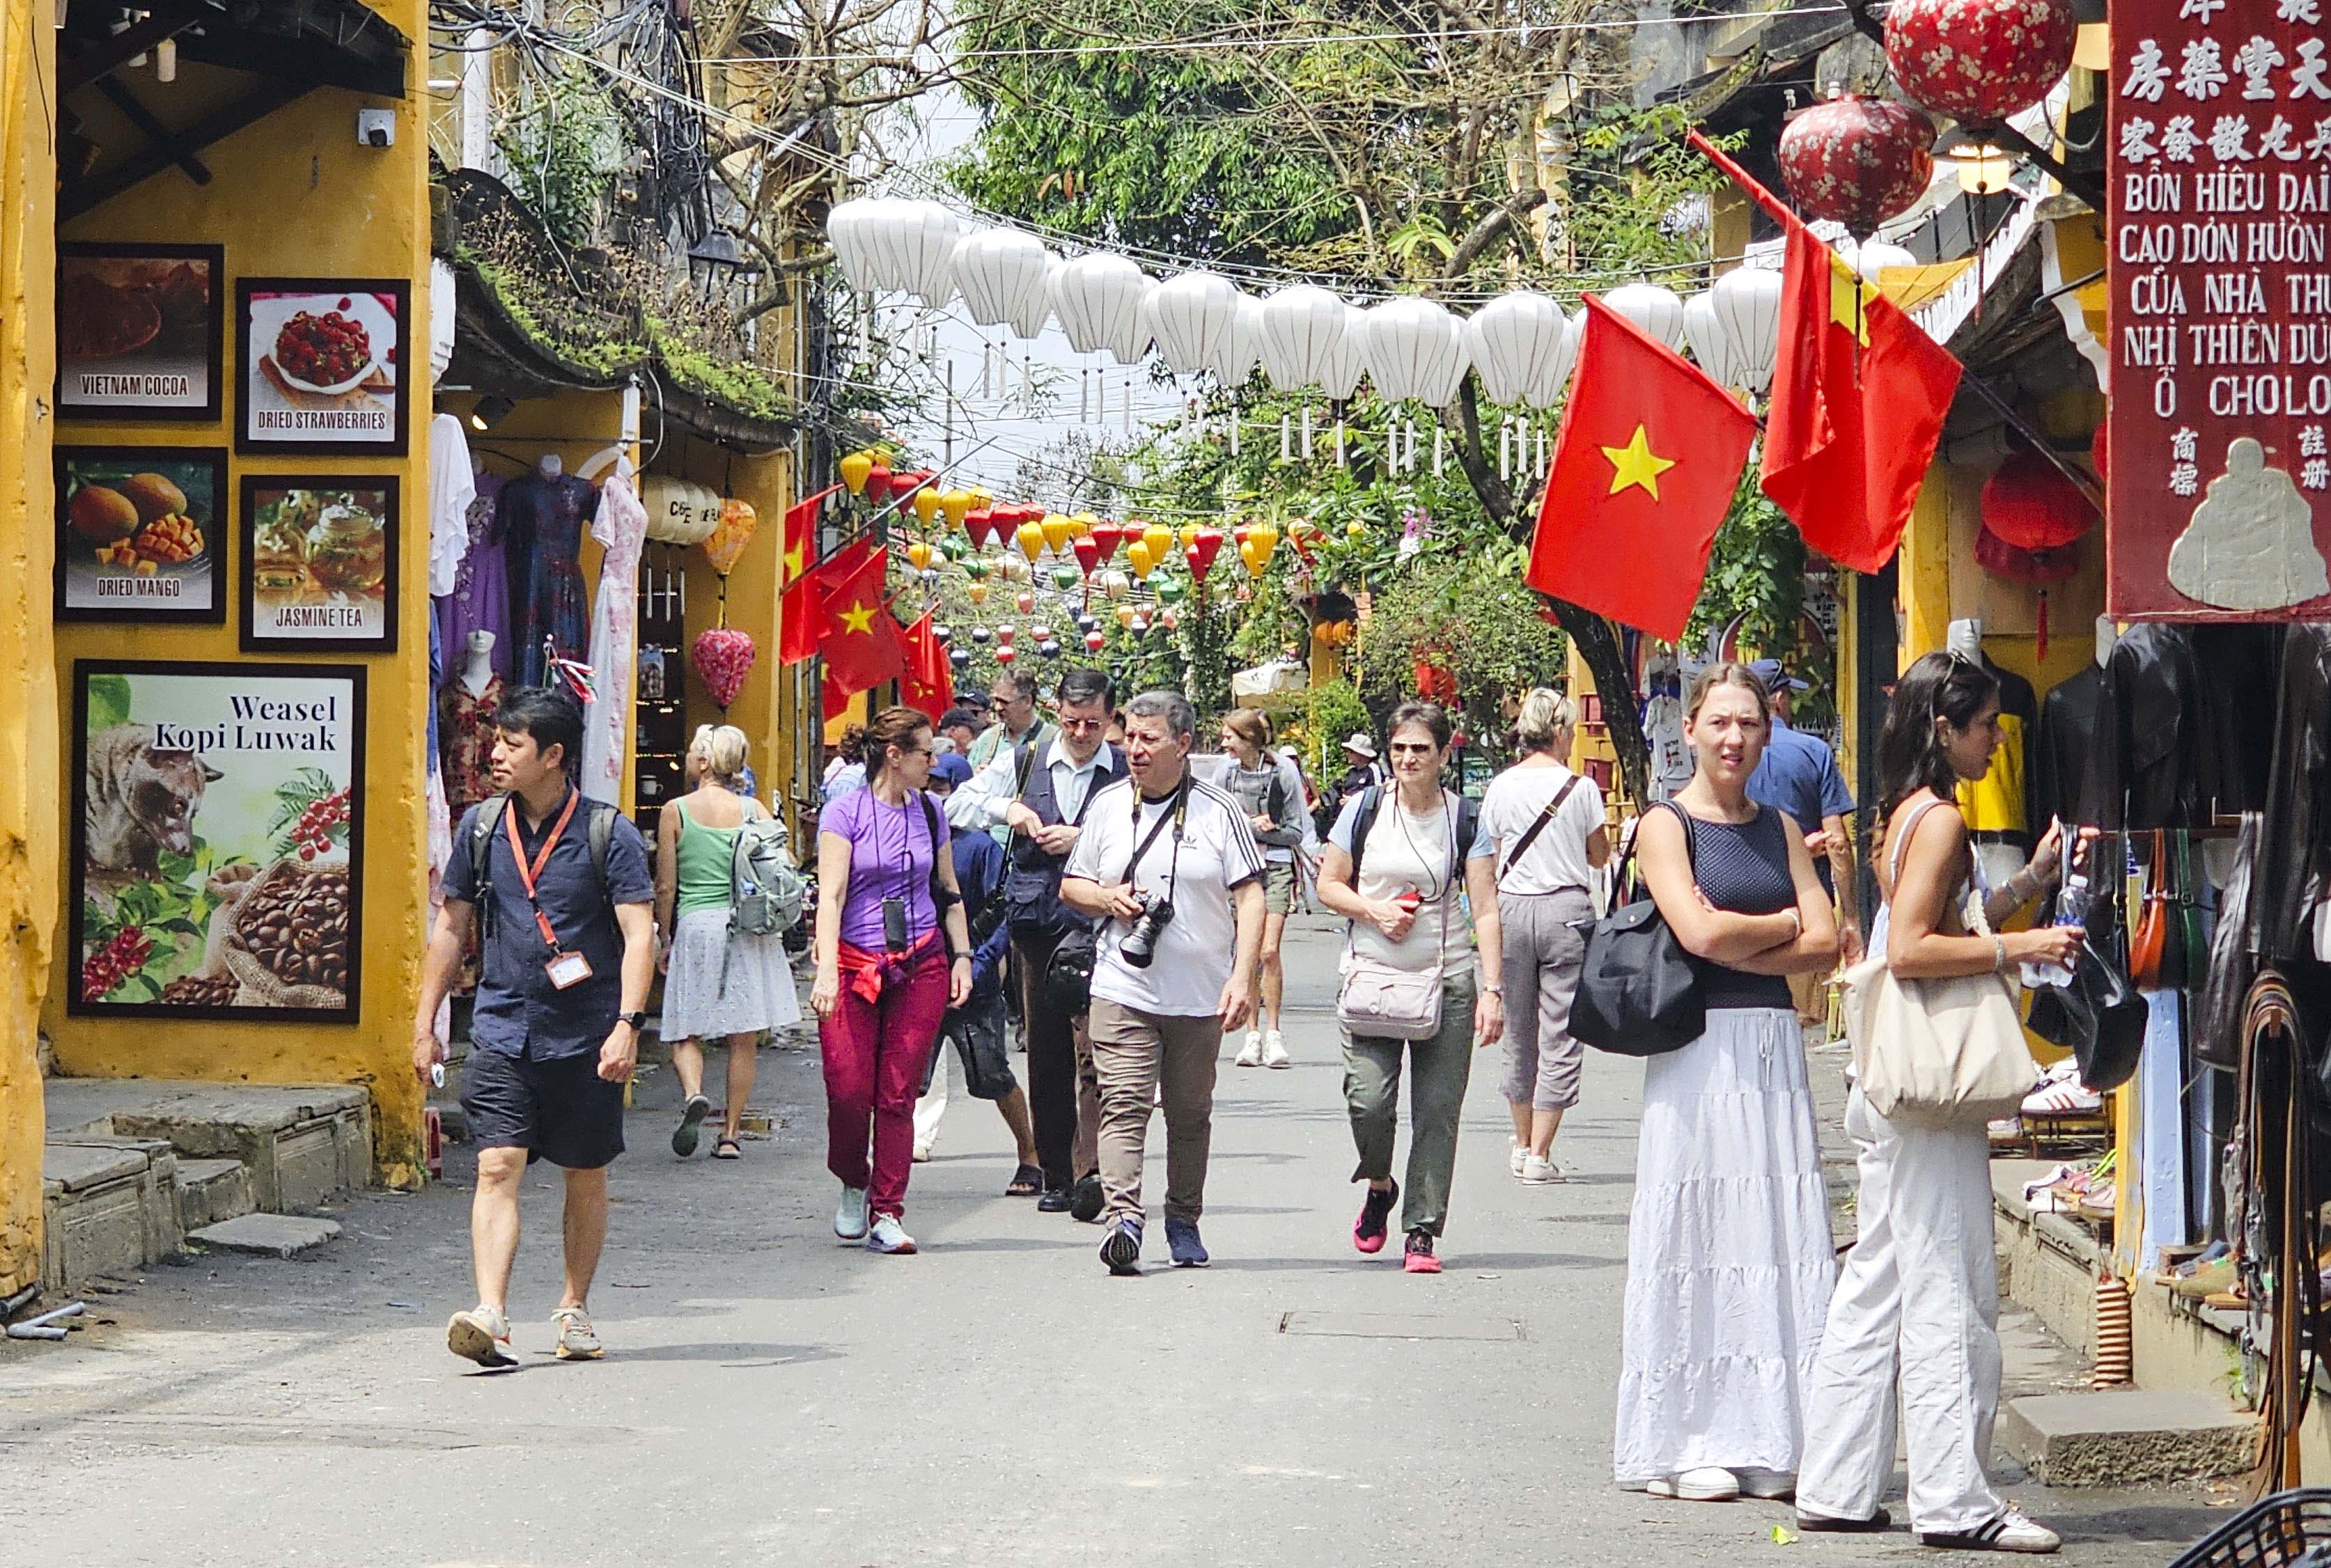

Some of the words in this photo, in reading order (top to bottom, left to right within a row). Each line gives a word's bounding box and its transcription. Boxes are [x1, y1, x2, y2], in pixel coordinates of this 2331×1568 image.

[2119, 224, 2175, 263] CAO
[2204, 266, 2268, 314] NHÀ
[2188, 316, 2280, 366] THIÊN
[81, 376, 141, 395] VIETNAM
[145, 376, 188, 395] COCOA
[258, 411, 293, 428] DRIED
[295, 411, 386, 430] STRAWBERRIES
[98, 579, 132, 596] DRIED
[137, 579, 180, 597] MANGO
[276, 608, 335, 627] JASMINE
[338, 609, 362, 627] TEA
[230, 696, 336, 721] Weasel
[156, 723, 225, 753] Kopi
[235, 726, 336, 751] Luwak
